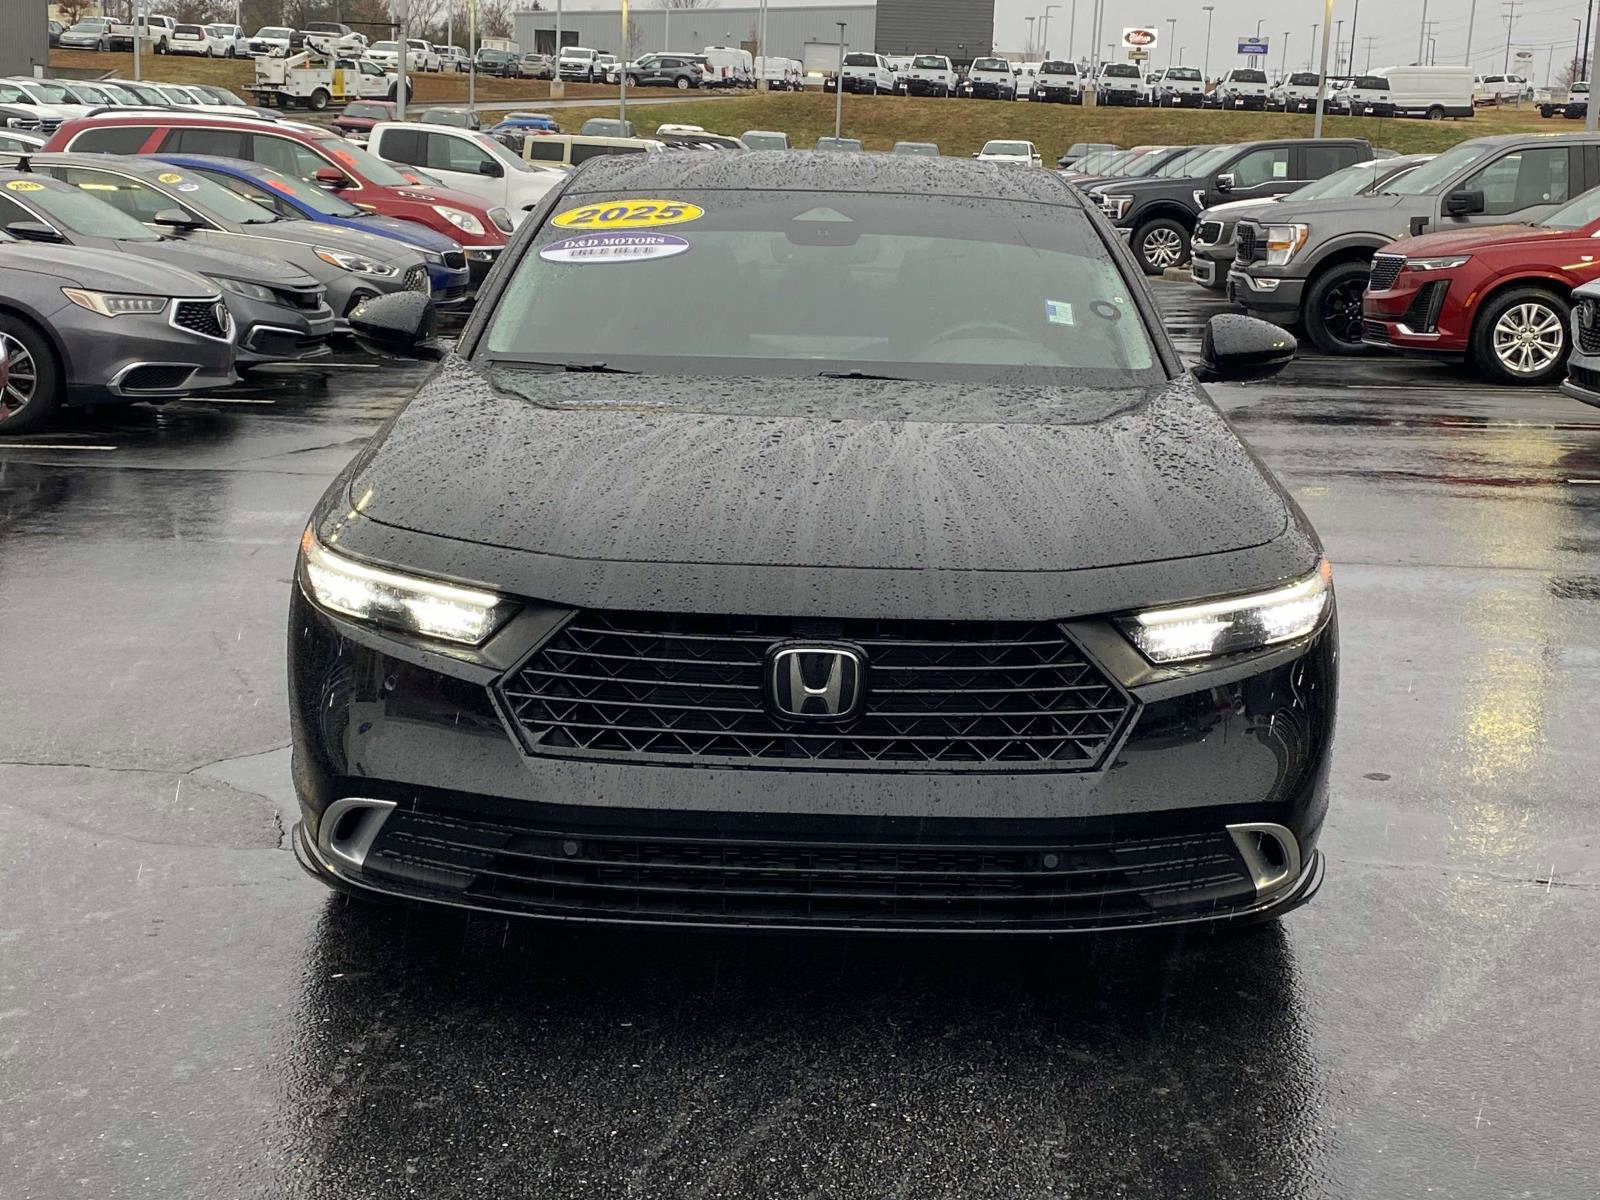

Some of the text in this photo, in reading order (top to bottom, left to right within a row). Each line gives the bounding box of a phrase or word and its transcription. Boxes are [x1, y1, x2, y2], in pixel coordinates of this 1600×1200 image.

[565, 205, 689, 225] 2025
[563, 236, 665, 249] D&D MOTORS
